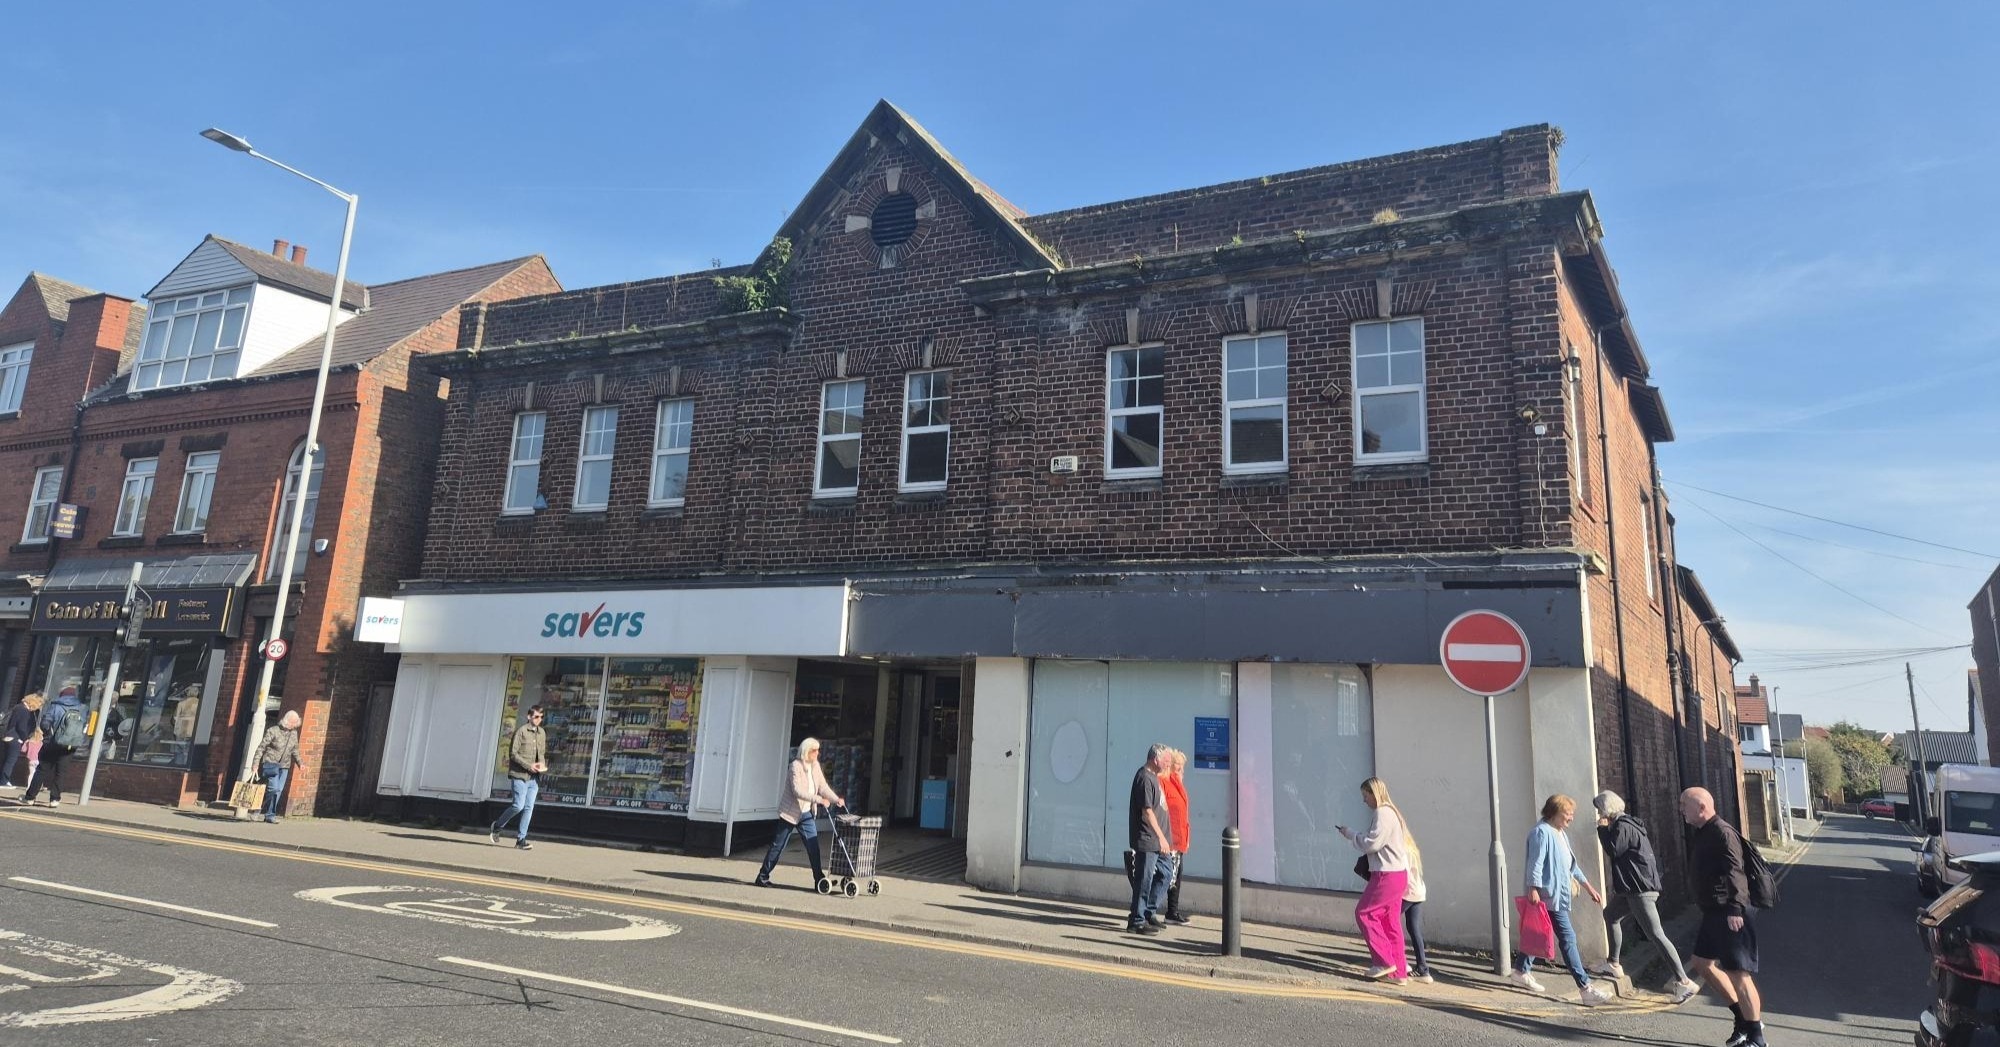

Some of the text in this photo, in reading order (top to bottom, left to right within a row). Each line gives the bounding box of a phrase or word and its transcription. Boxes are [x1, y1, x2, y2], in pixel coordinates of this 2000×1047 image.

[47, 600, 168, 619] Cain of Heall
[365, 615, 399, 625] savers
[541, 602, 645, 638] savers
[270, 645, 283, 654] 20
[561, 795, 574, 803] 60%
[575, 796, 586, 804] OFF
[616, 799, 630, 807] 60%
[630, 800, 642, 808] OFF
[669, 803, 683, 811] 60%
